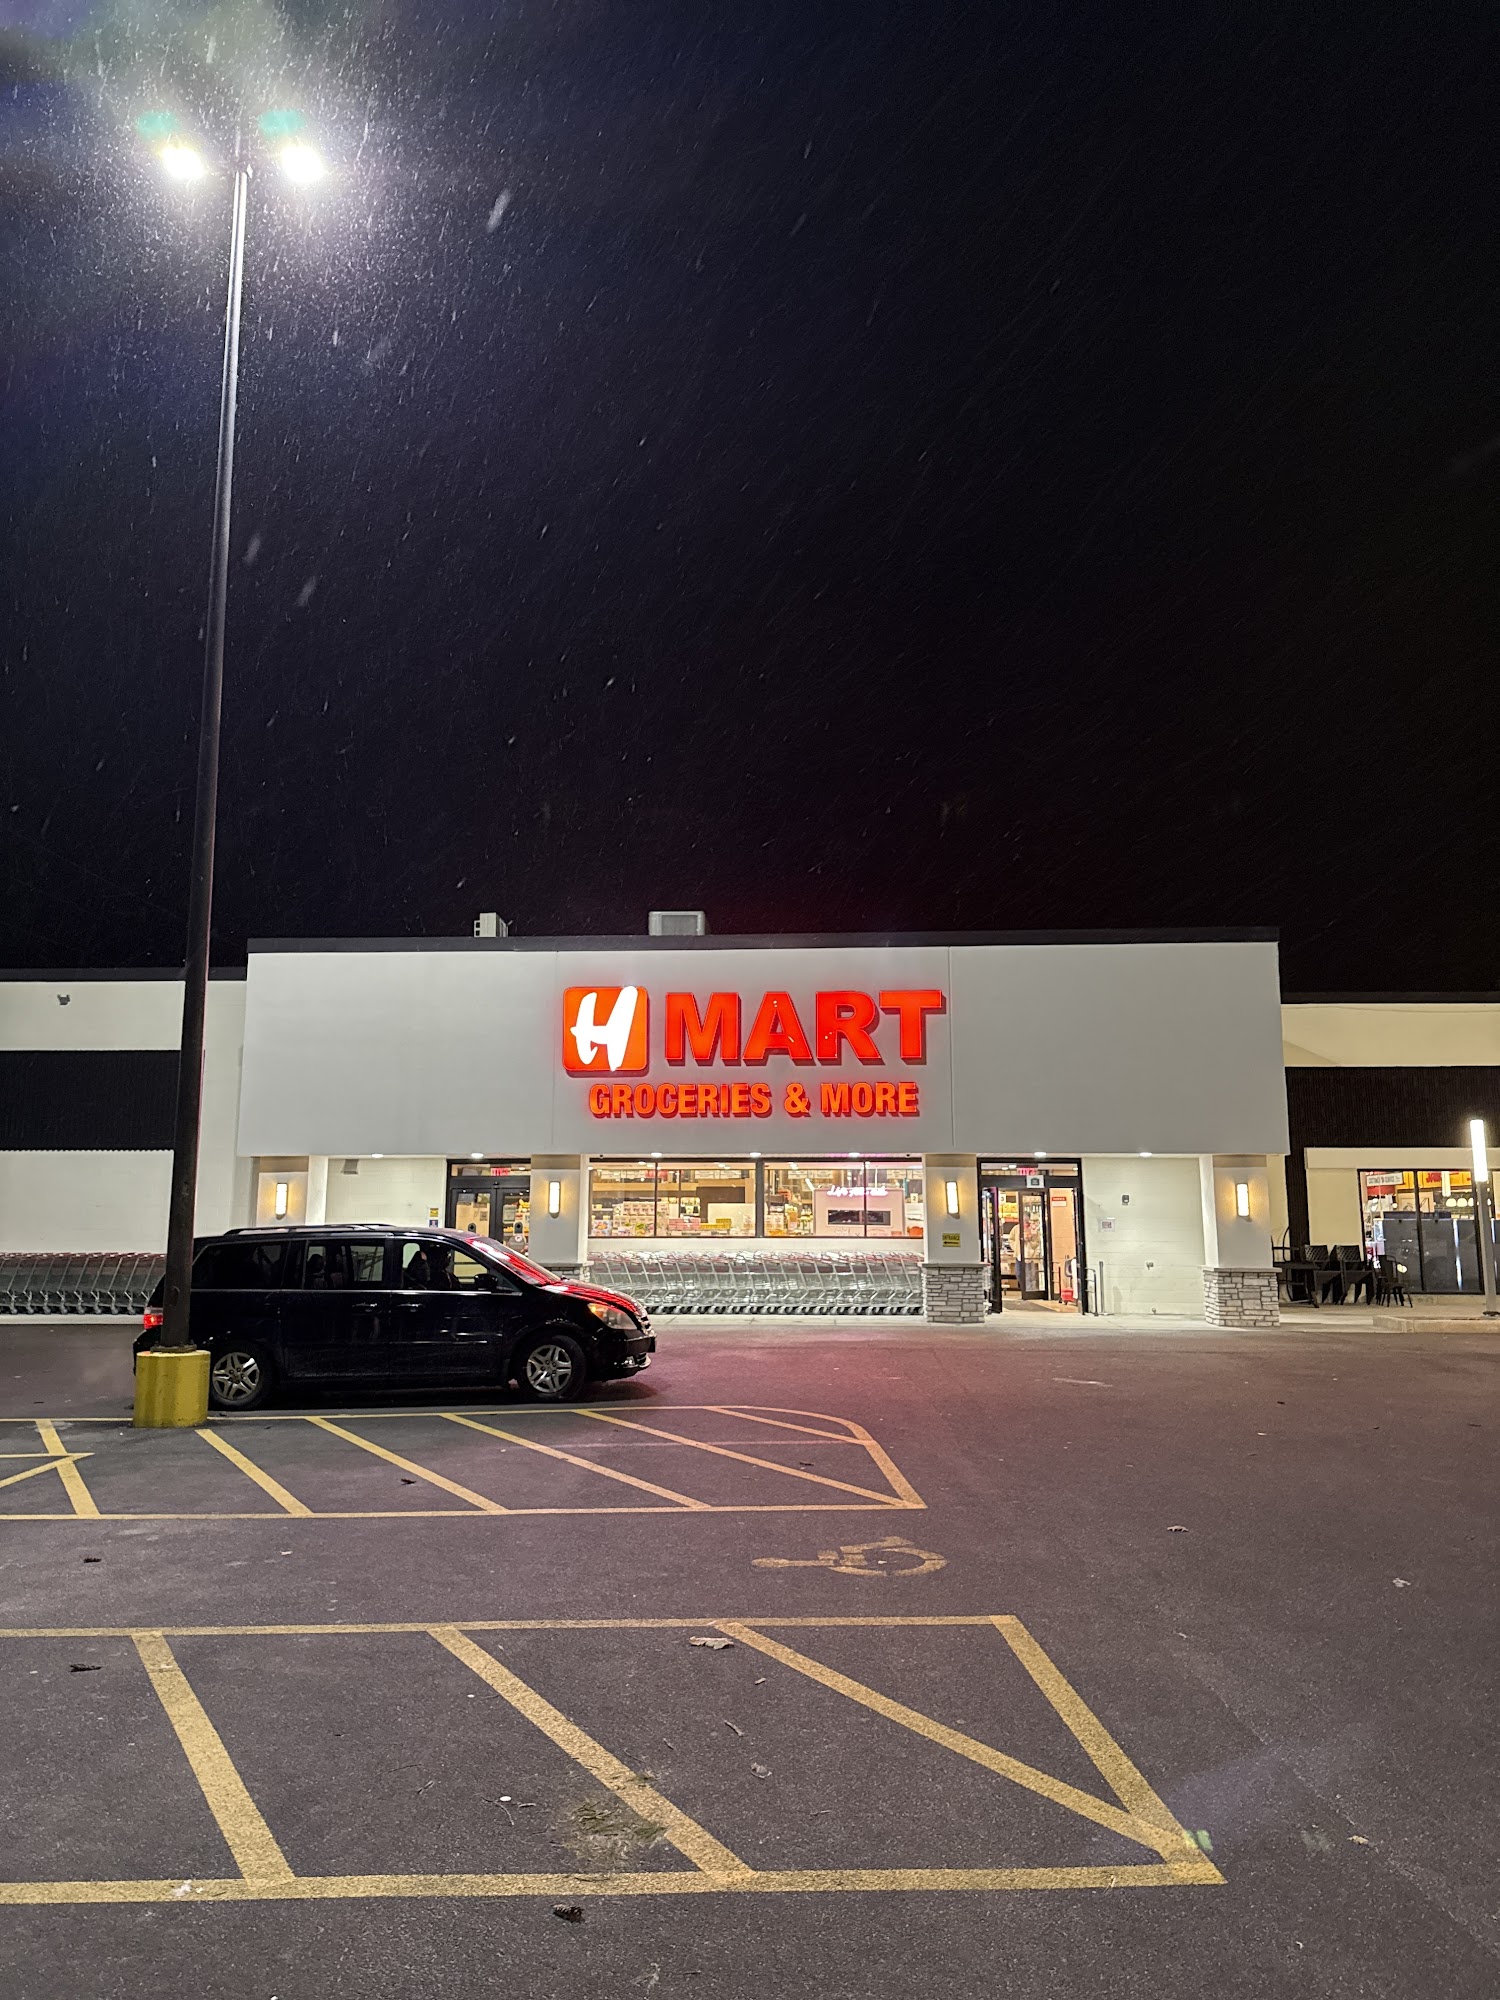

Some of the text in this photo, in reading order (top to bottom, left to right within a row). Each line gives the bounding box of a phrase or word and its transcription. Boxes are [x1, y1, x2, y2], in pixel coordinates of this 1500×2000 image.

[571, 986, 944, 1071] H MART
[589, 1082, 919, 1116] GROCERIES & MORE
